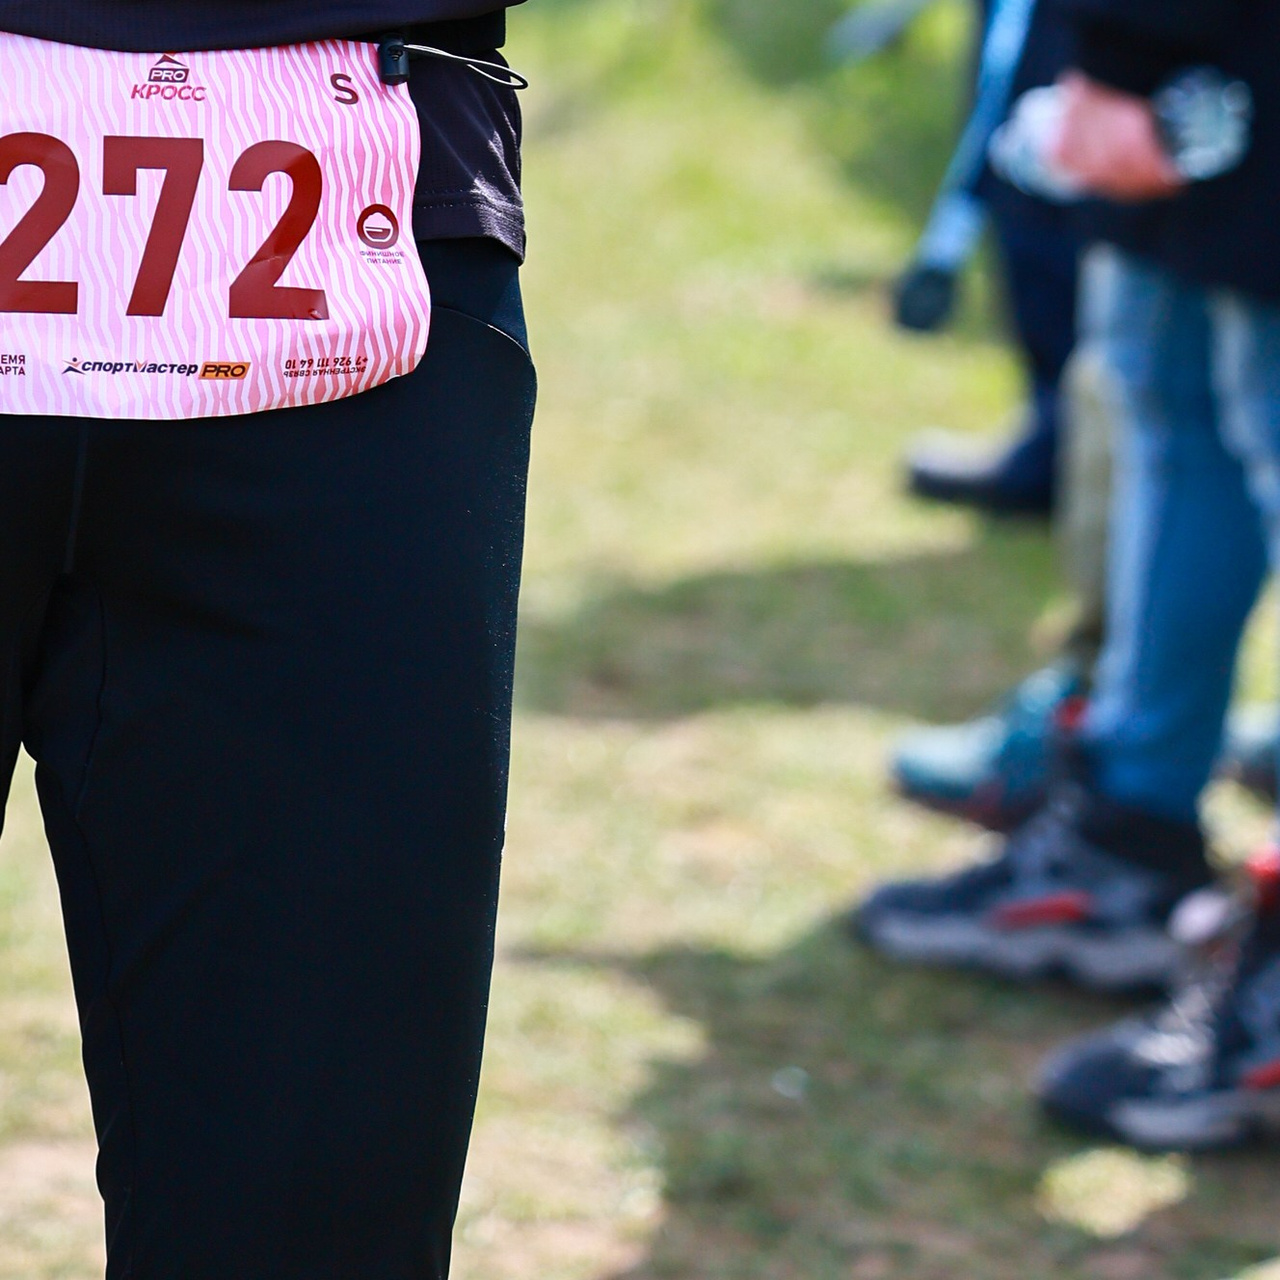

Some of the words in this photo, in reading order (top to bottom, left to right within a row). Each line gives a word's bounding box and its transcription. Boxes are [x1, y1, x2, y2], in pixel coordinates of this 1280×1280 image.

[150, 69, 187, 81] PRO
[131, 84, 207, 101] КРОСС
[330, 73, 359, 104] S
[285, 359, 297, 370] 10
[300, 358, 314, 369] 64
[316, 358, 330, 368] 111
[333, 357, 352, 367] 926
[355, 355, 369, 366] +7
[201, 364, 246, 377] PRO
